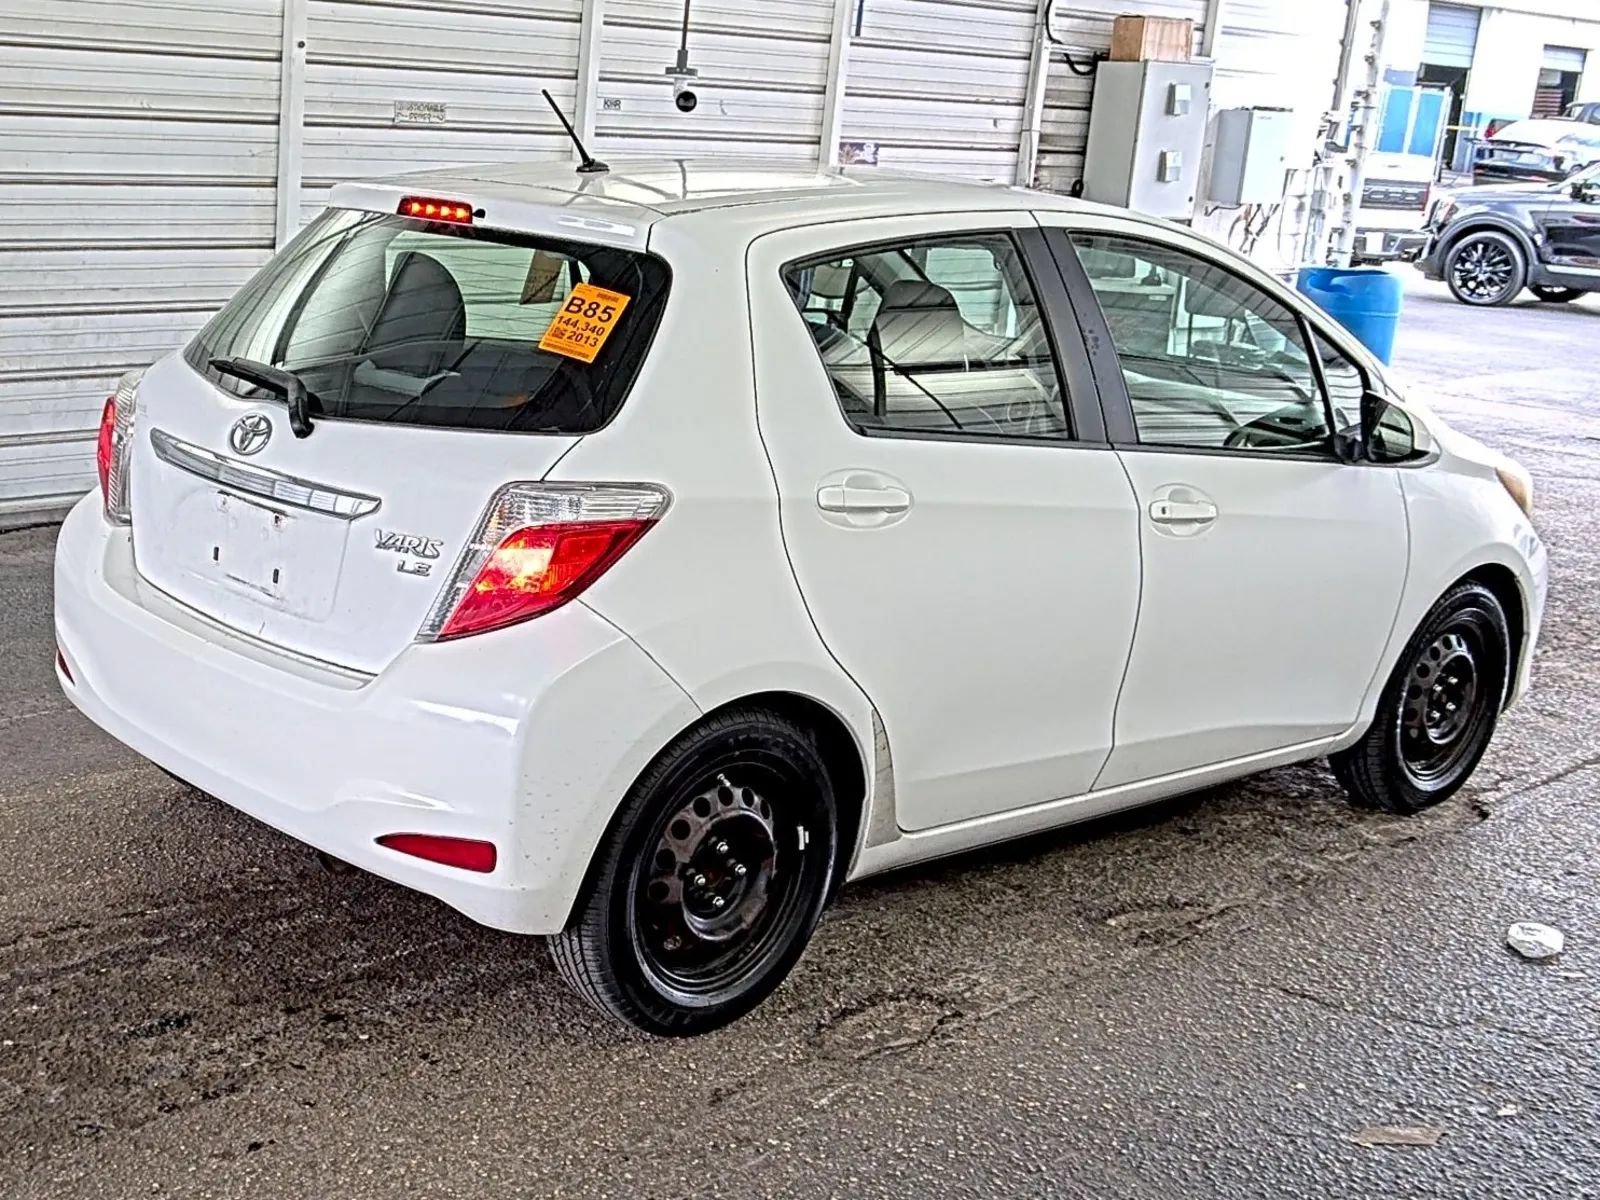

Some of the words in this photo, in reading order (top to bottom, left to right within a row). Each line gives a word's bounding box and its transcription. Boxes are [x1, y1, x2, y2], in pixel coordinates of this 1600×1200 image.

[564, 296, 617, 323] B85
[557, 315, 605, 337] 144,340
[567, 330, 599, 347] 2013
[374, 528, 444, 559] YARIS
[396, 560, 432, 577] LE
